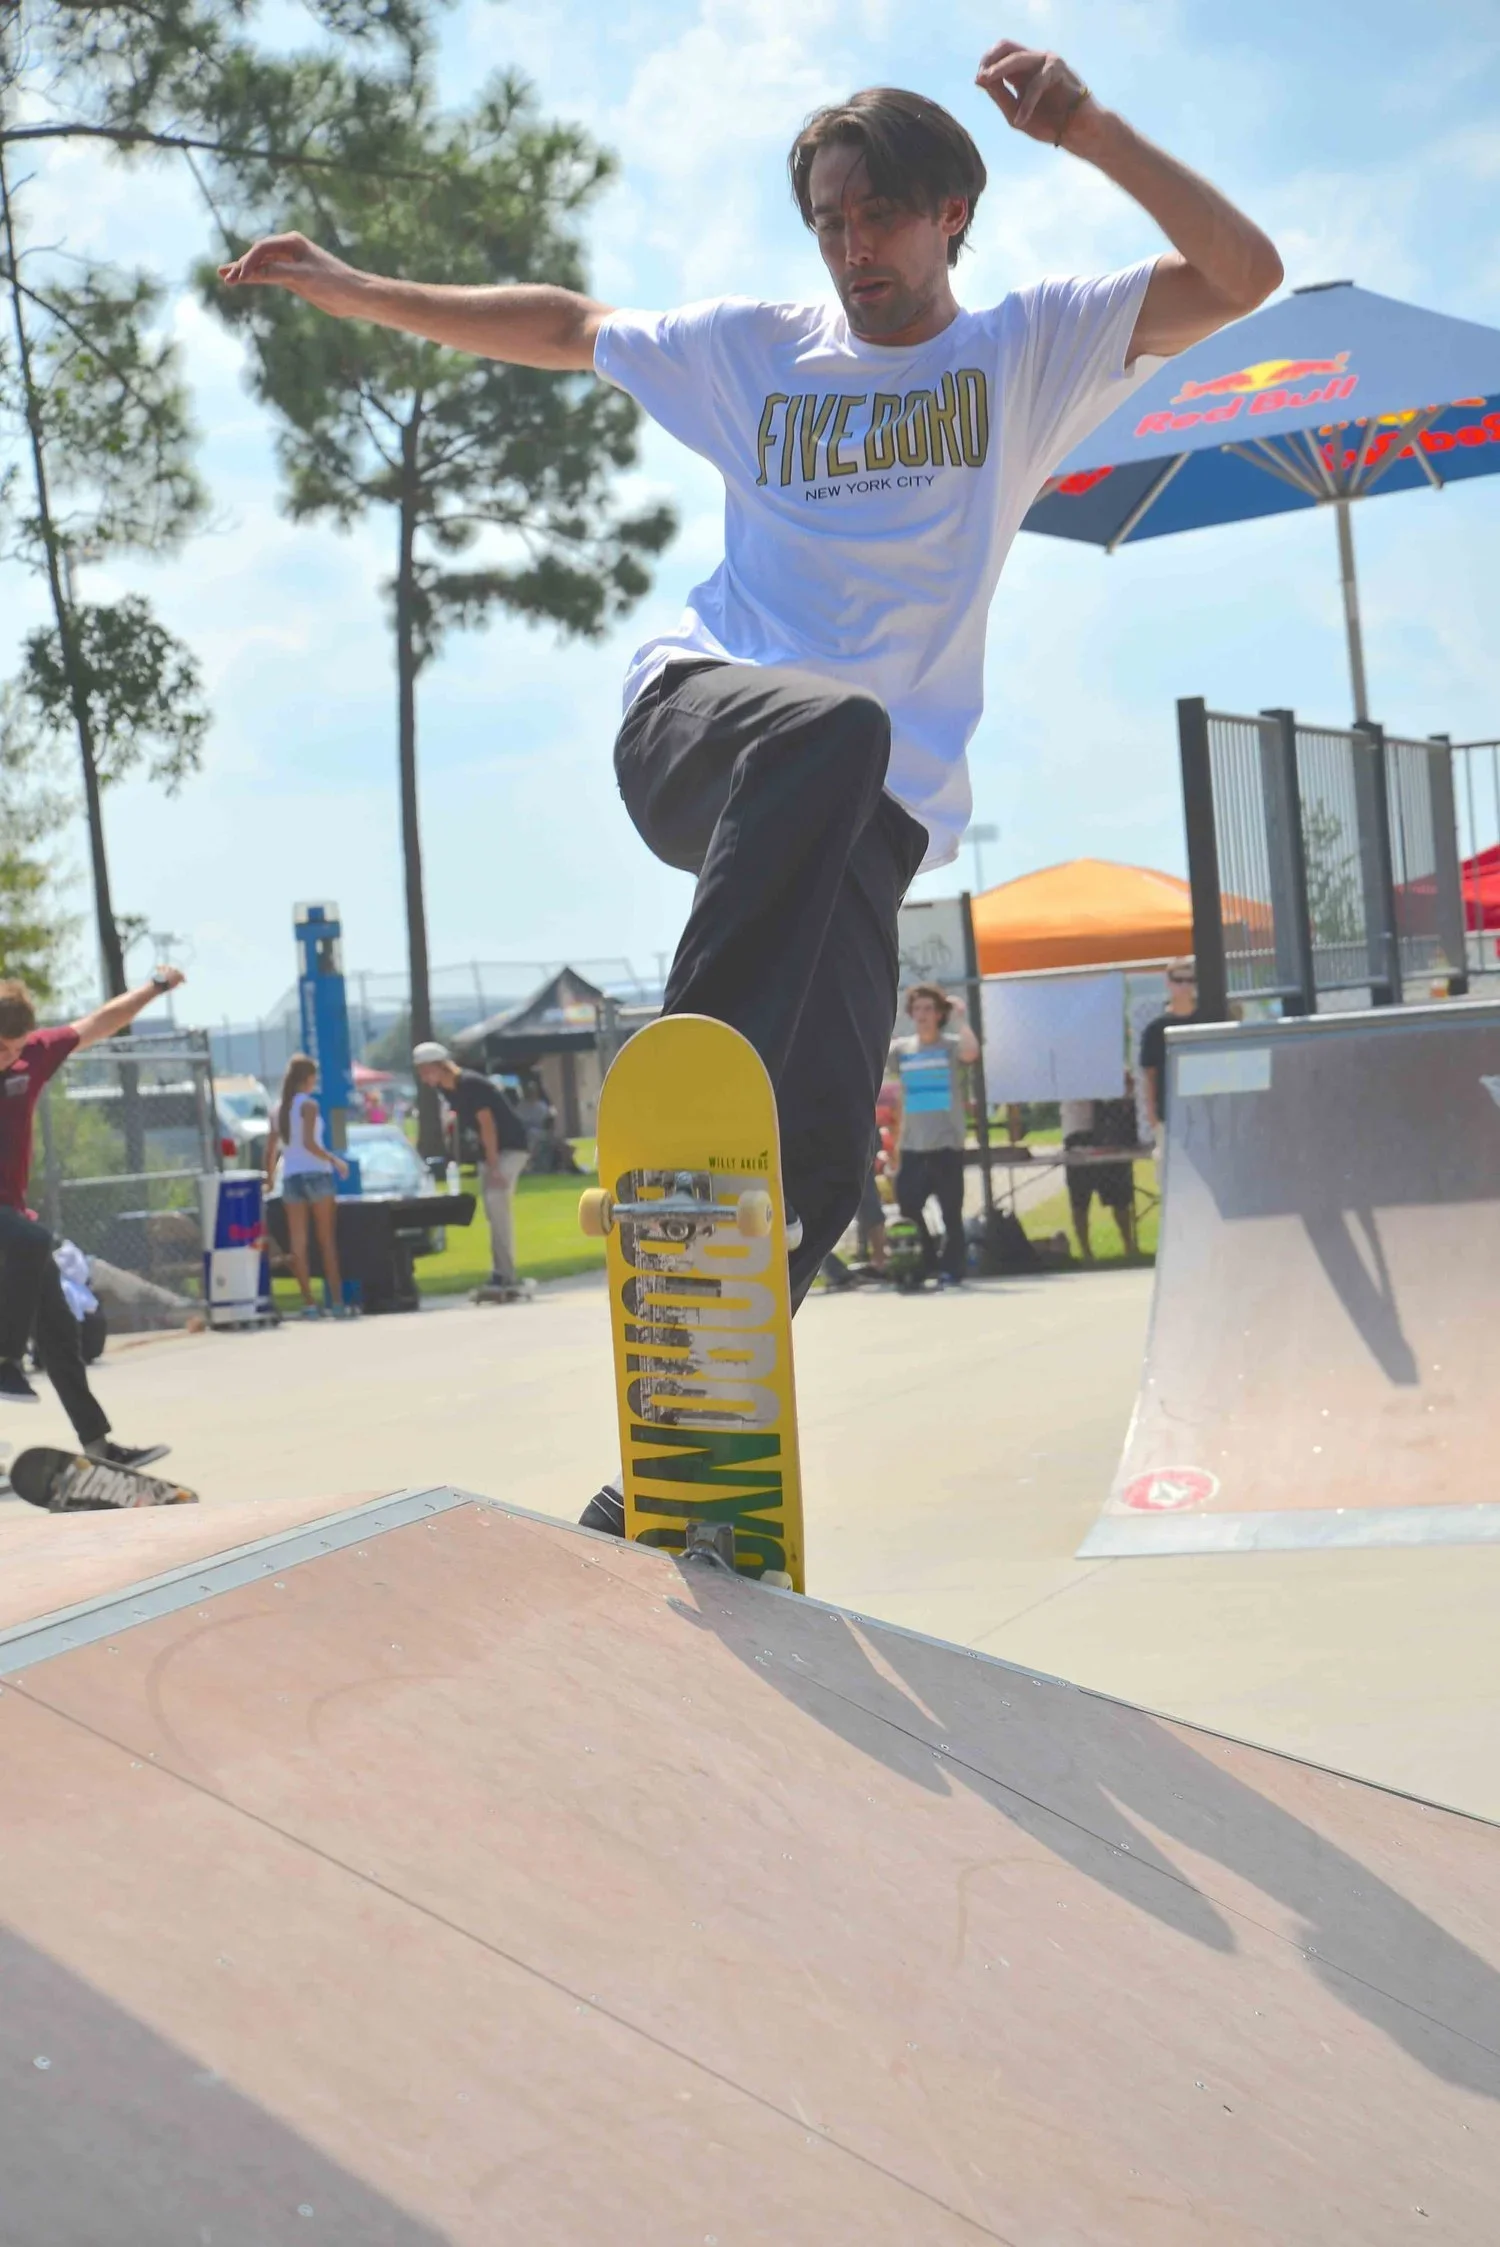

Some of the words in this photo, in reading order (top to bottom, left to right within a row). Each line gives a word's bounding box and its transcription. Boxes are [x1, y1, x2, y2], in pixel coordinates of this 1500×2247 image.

[1134, 396, 1245, 437] Red
[1248, 374, 1359, 416] Bull
[756, 393, 867, 487] FIVE
[805, 485, 841, 501] NEW
[846, 478, 892, 495] YORK
[896, 475, 935, 488] CITY
[708, 1156, 736, 1169] WILLY
